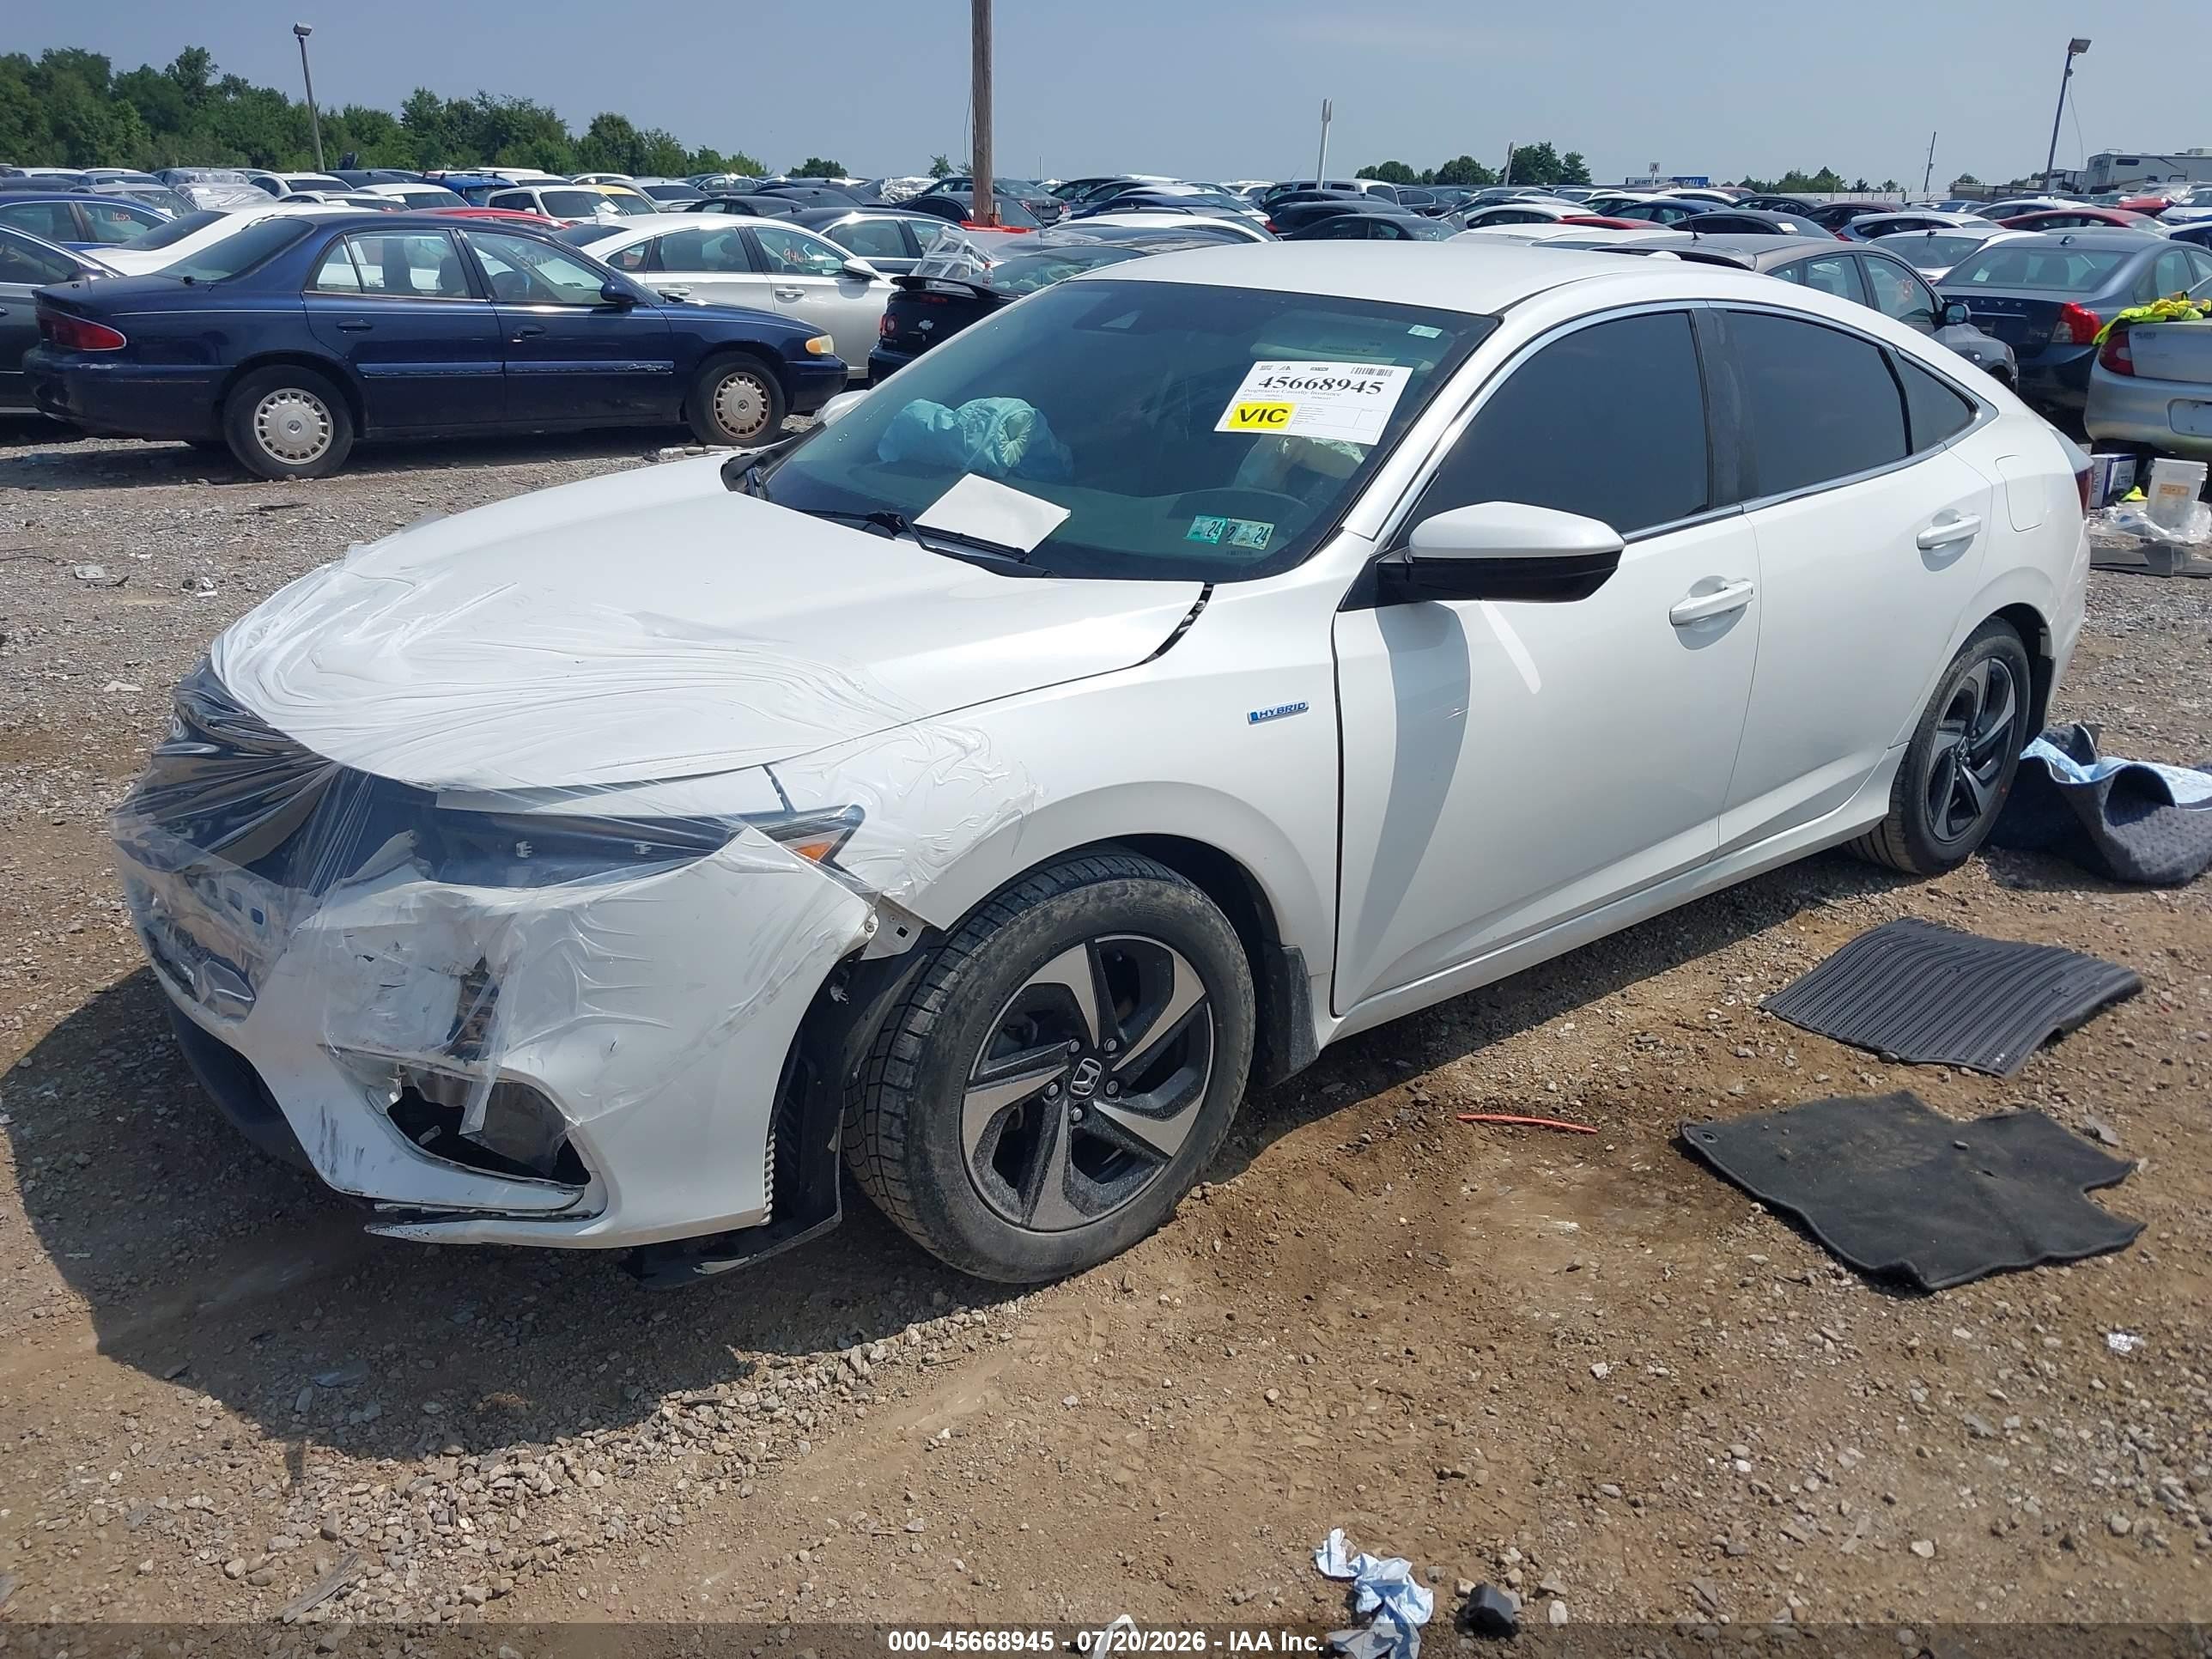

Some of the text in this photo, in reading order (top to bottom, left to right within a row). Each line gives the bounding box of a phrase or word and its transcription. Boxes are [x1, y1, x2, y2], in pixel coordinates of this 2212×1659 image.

[1947, 299, 2022, 307] VOLVO
[1258, 375, 1385, 395] 45668945
[1239, 408, 1289, 423] VIC
[1206, 520, 1222, 538] 24
[1253, 526, 1271, 545] 24
[1259, 702, 1306, 718] HYBRID
